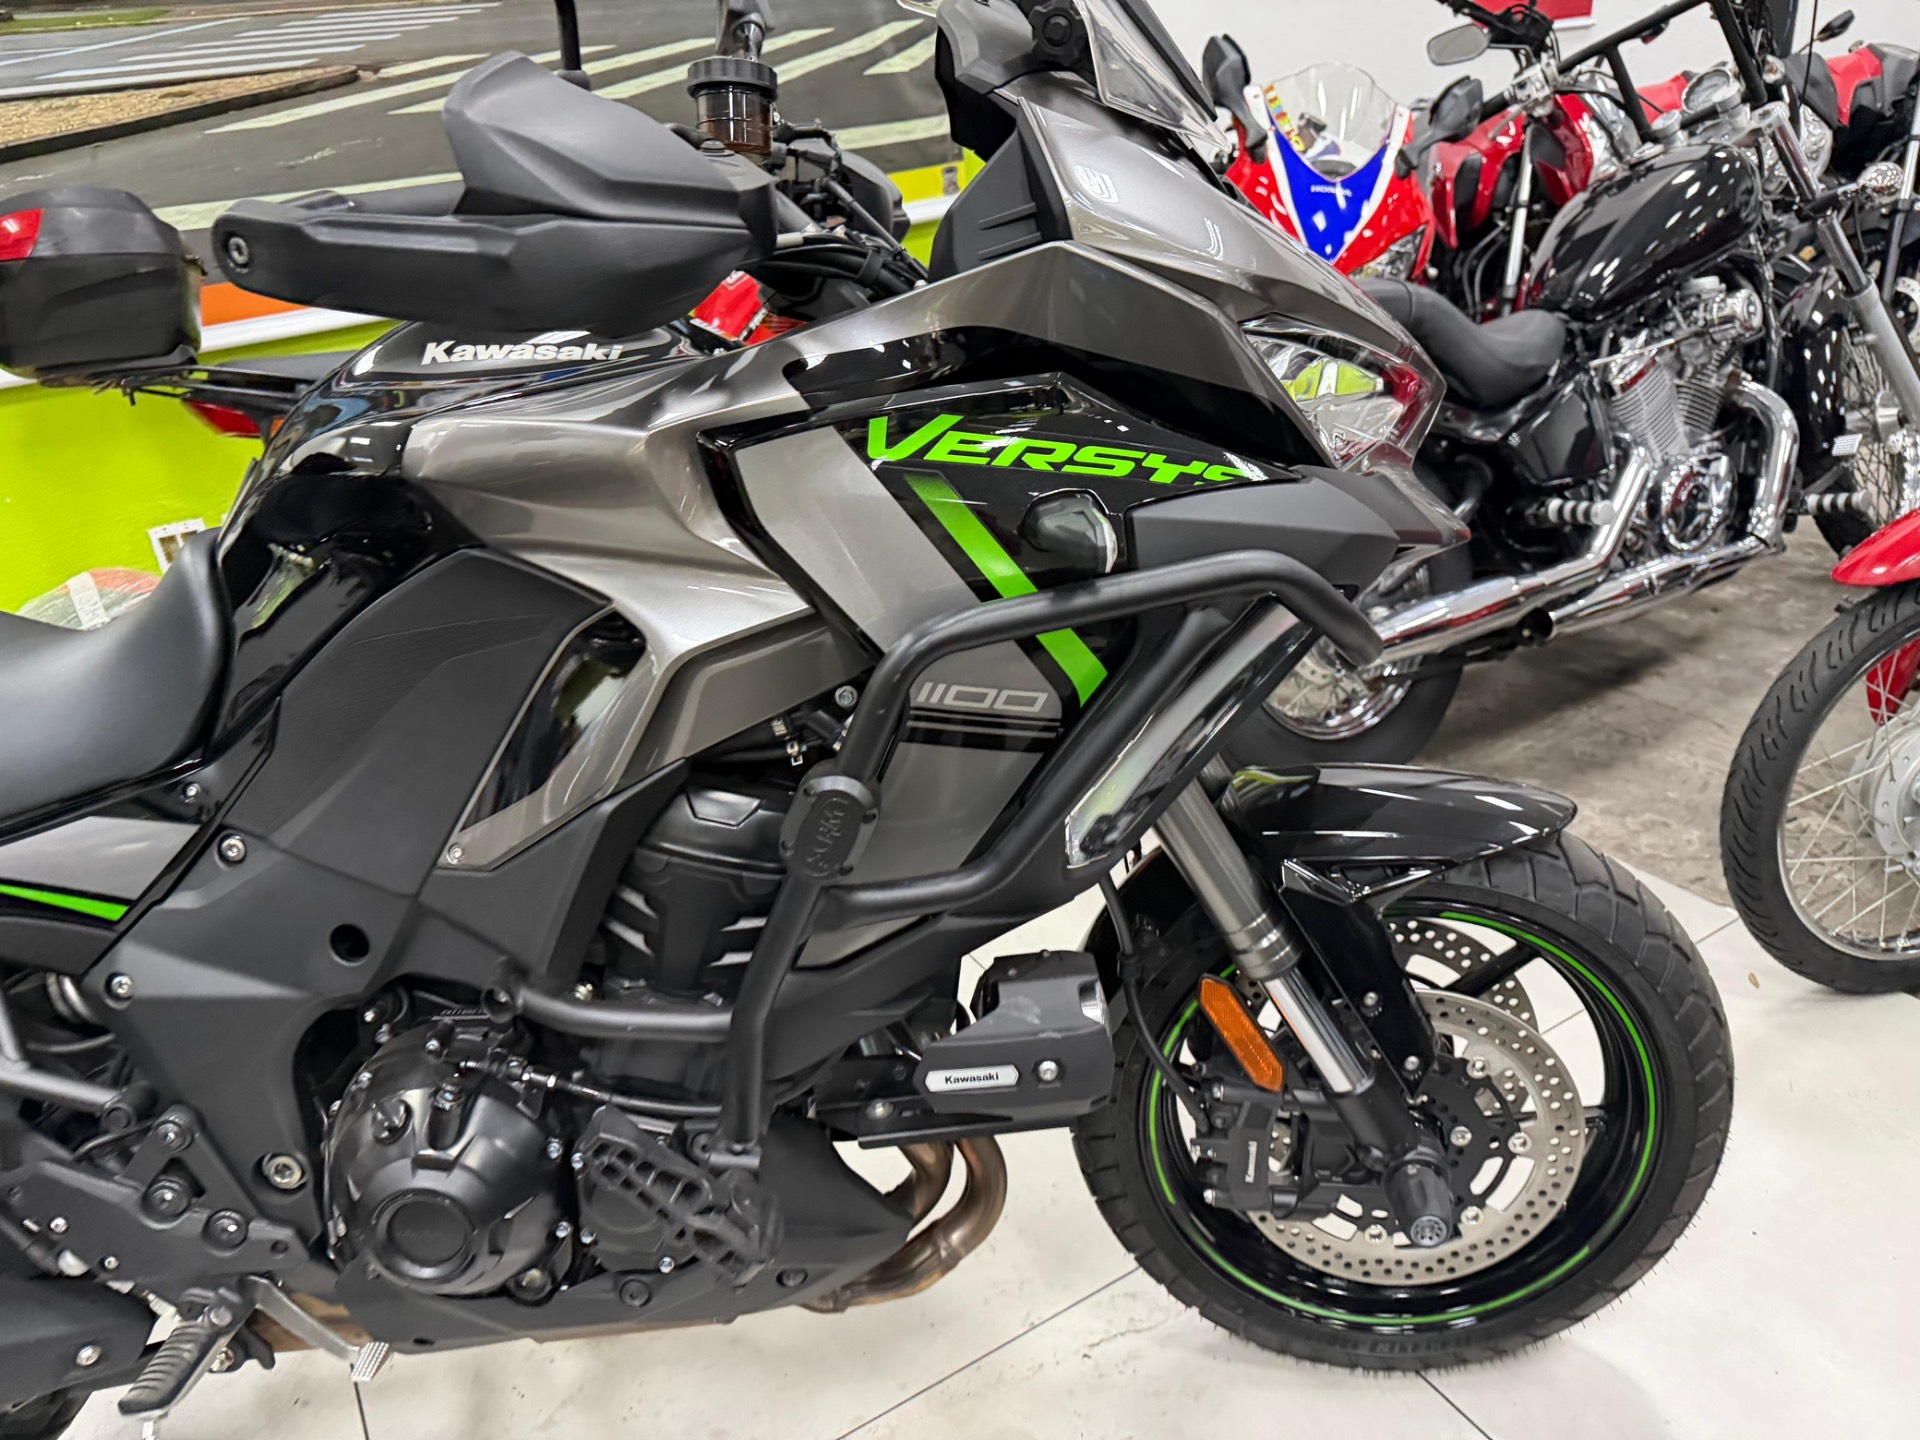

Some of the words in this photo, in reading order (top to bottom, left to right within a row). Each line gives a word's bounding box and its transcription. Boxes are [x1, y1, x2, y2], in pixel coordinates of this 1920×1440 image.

[421, 340, 624, 365] Kawasaki
[916, 681, 1048, 712] 1100
[944, 1072, 999, 1084] Kawasaki
